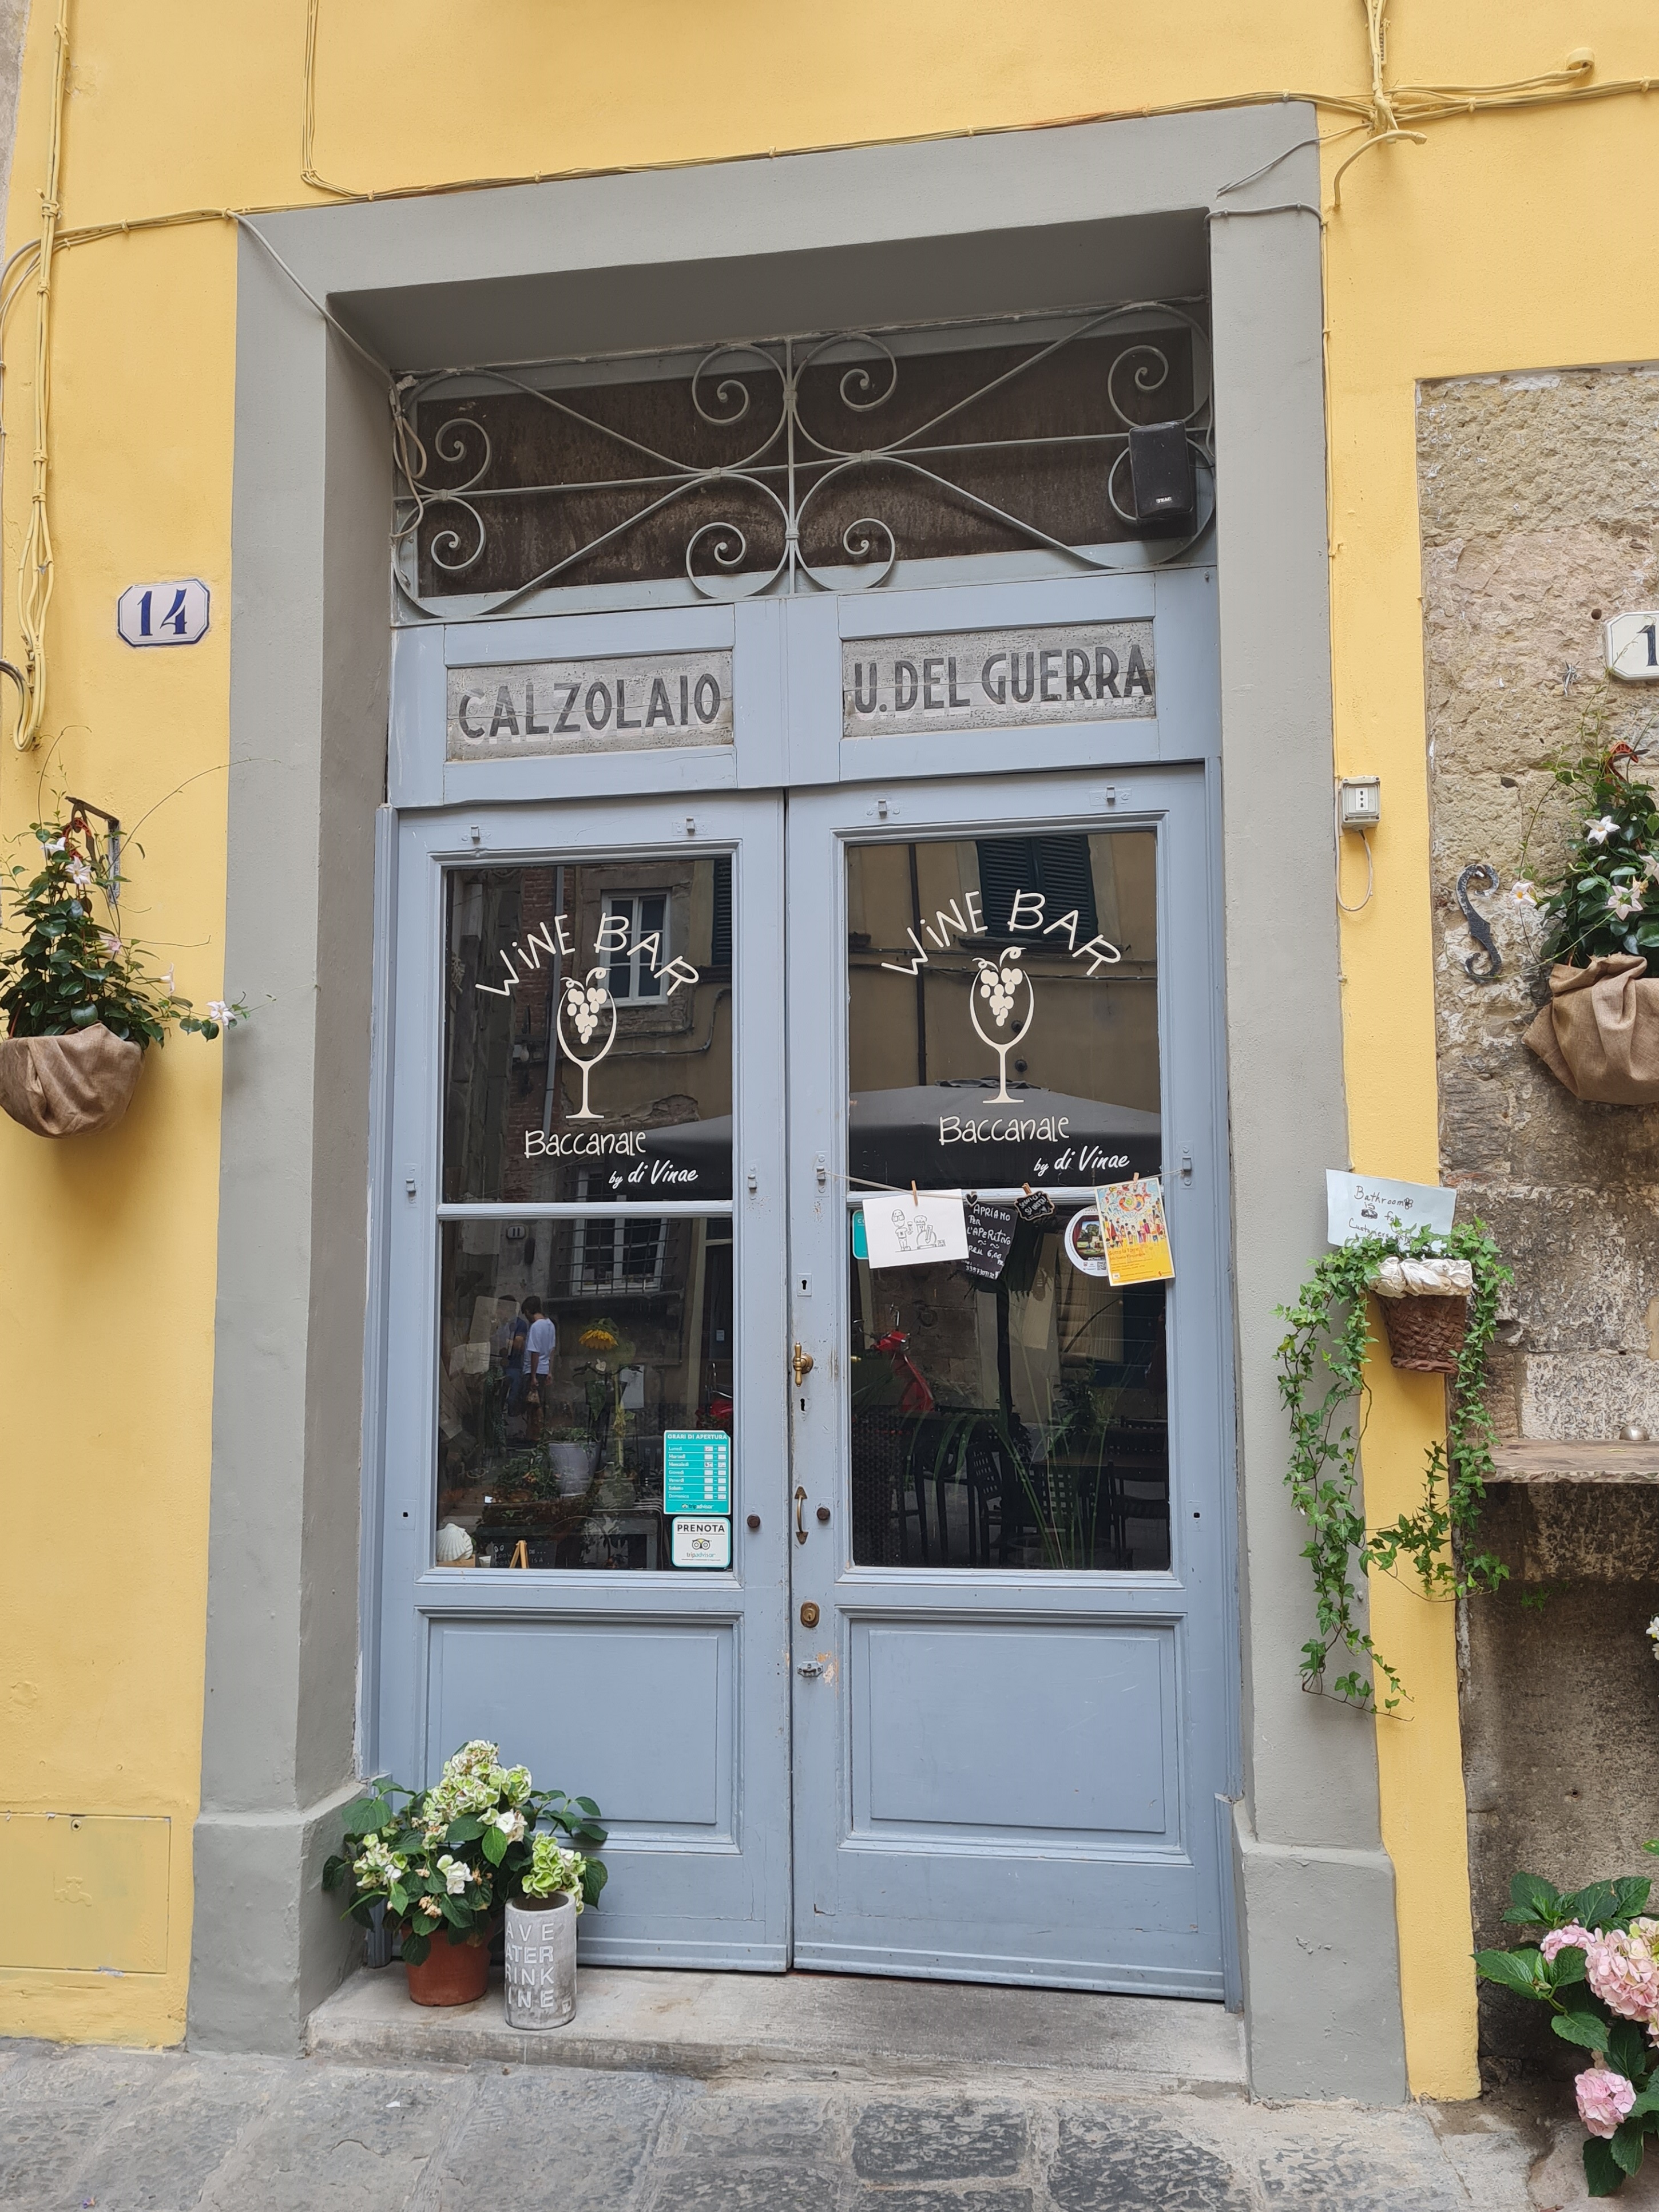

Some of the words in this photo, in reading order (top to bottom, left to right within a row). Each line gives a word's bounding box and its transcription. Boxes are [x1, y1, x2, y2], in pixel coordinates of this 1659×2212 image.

[137, 588, 188, 636] 14
[982, 644, 1152, 705] GUERRA
[459, 673, 720, 739] CALZOLAIO
[1007, 889, 1121, 976] BAR
[593, 913, 699, 996] BAR
[524, 1130, 647, 1158] Baccanale
[939, 1116, 1070, 1145] Baccanale
[609, 1171, 623, 1190] by
[628, 1162, 648, 1183] di
[650, 1160, 699, 1185] Vinae
[1034, 1158, 1049, 1176] by
[1054, 1149, 1075, 1170] di
[1078, 1145, 1130, 1171] Vinae
[1354, 1186, 1404, 1206] Bathroom
[1364, 1202, 1375, 1210] is
[677, 1524, 725, 1532] PRENOTA
